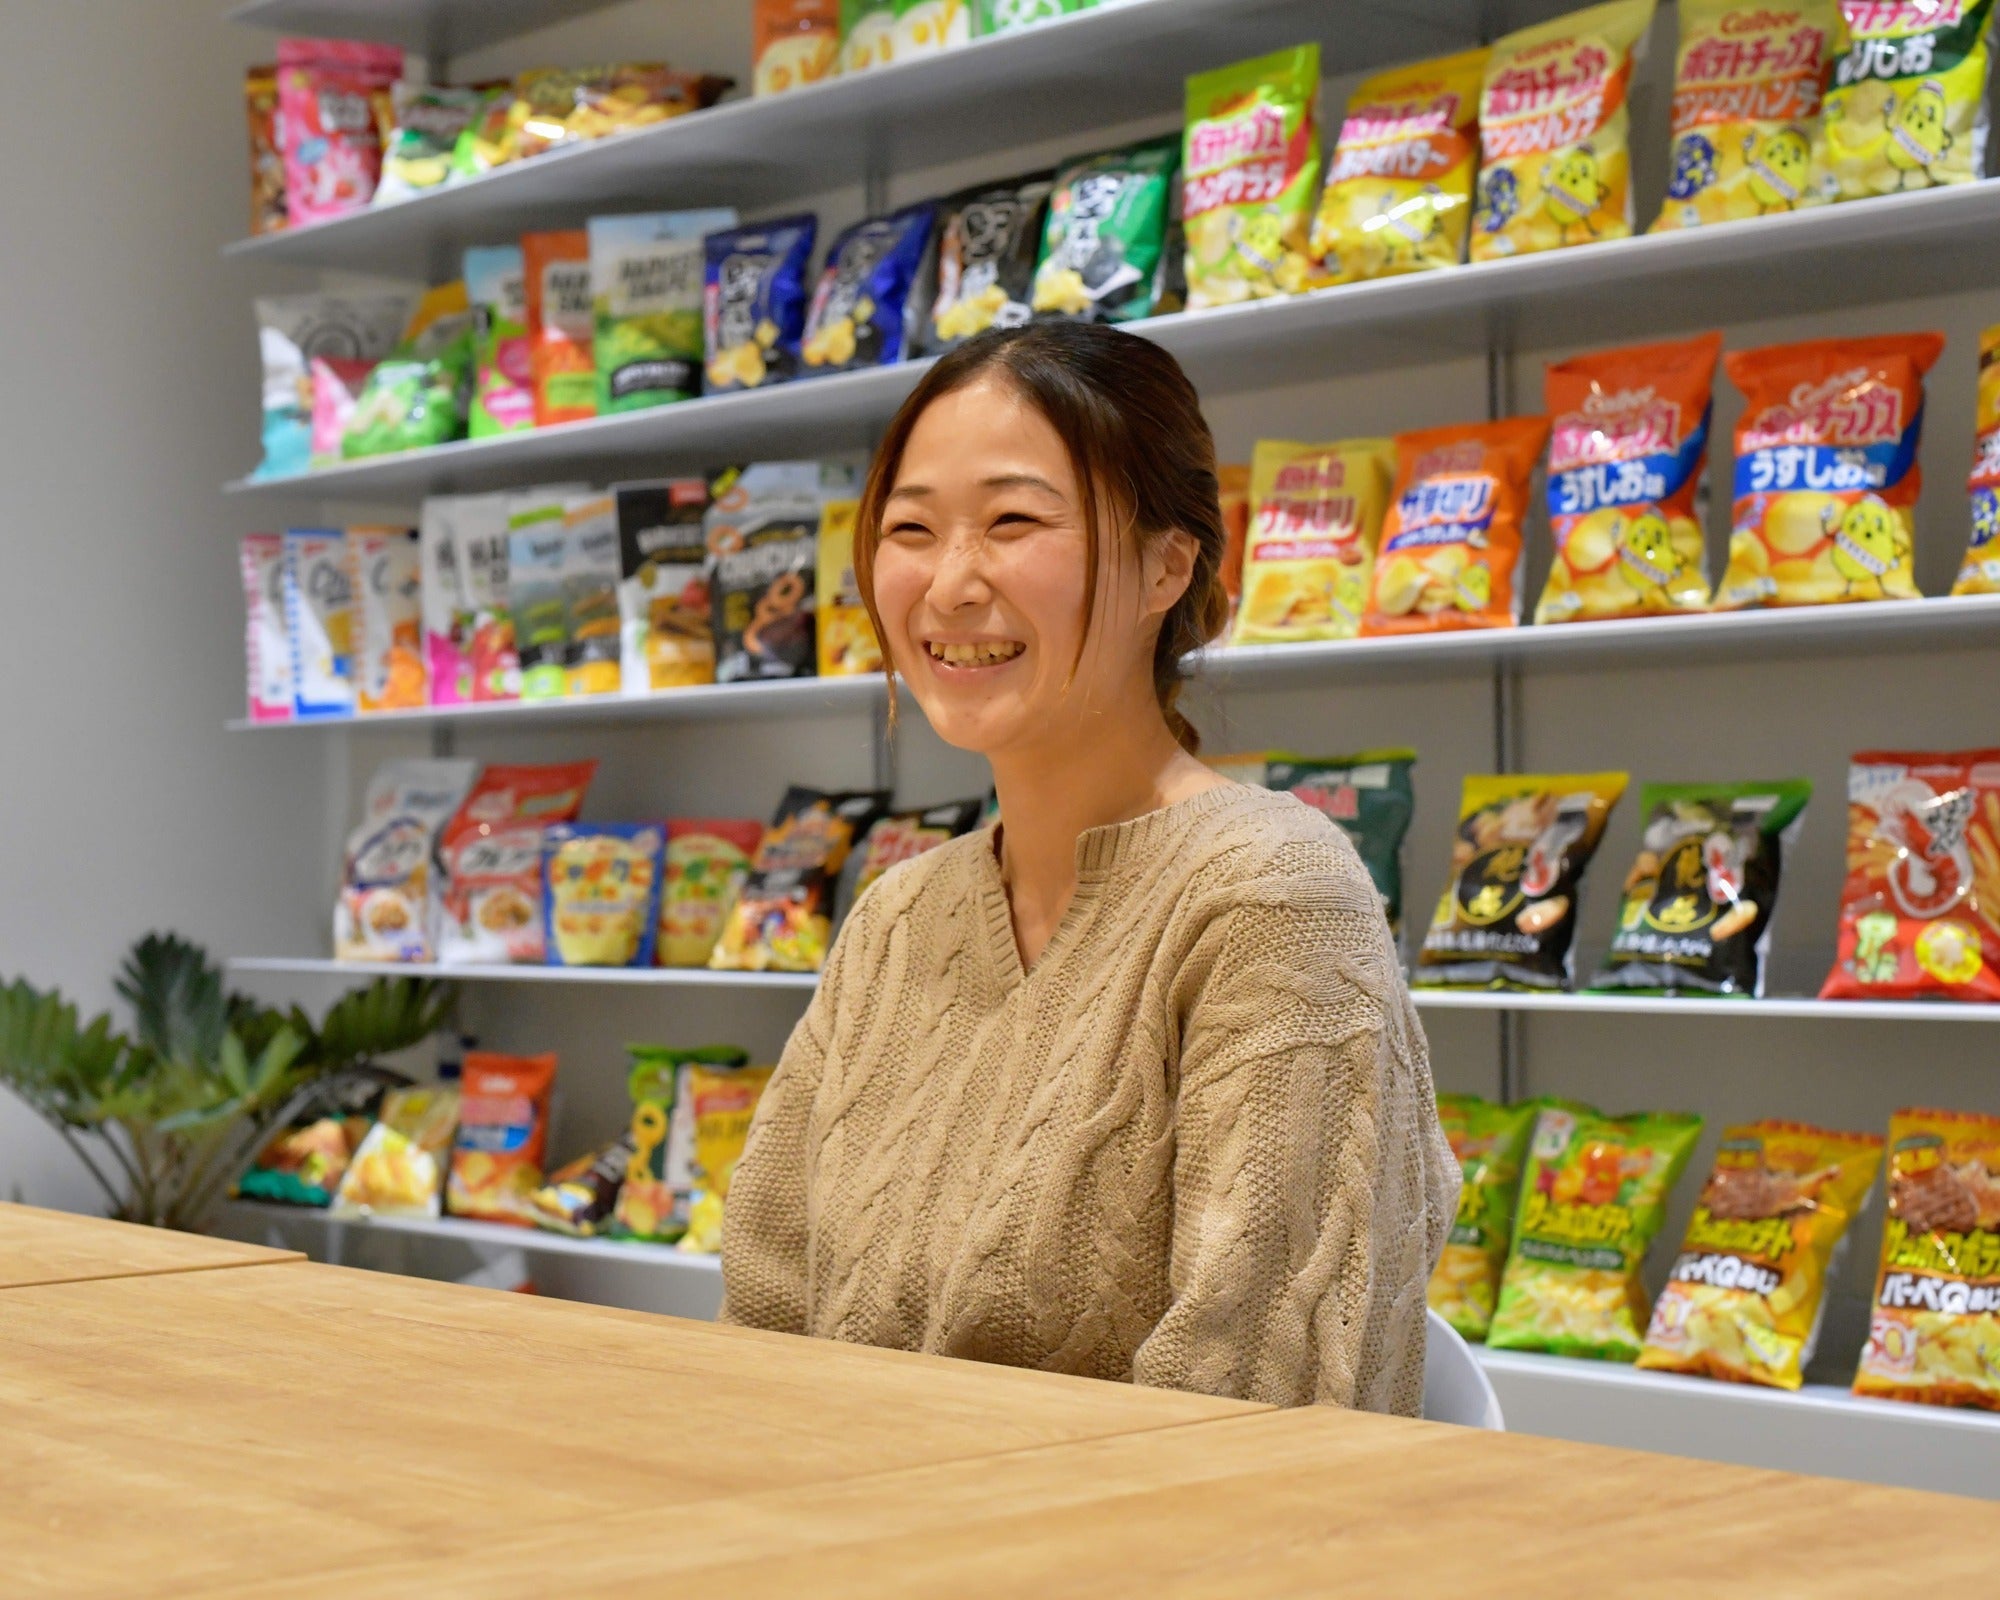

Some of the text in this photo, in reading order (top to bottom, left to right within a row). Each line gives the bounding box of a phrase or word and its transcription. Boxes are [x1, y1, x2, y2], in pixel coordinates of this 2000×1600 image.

[1838, 0, 1962, 31] テトチップス
